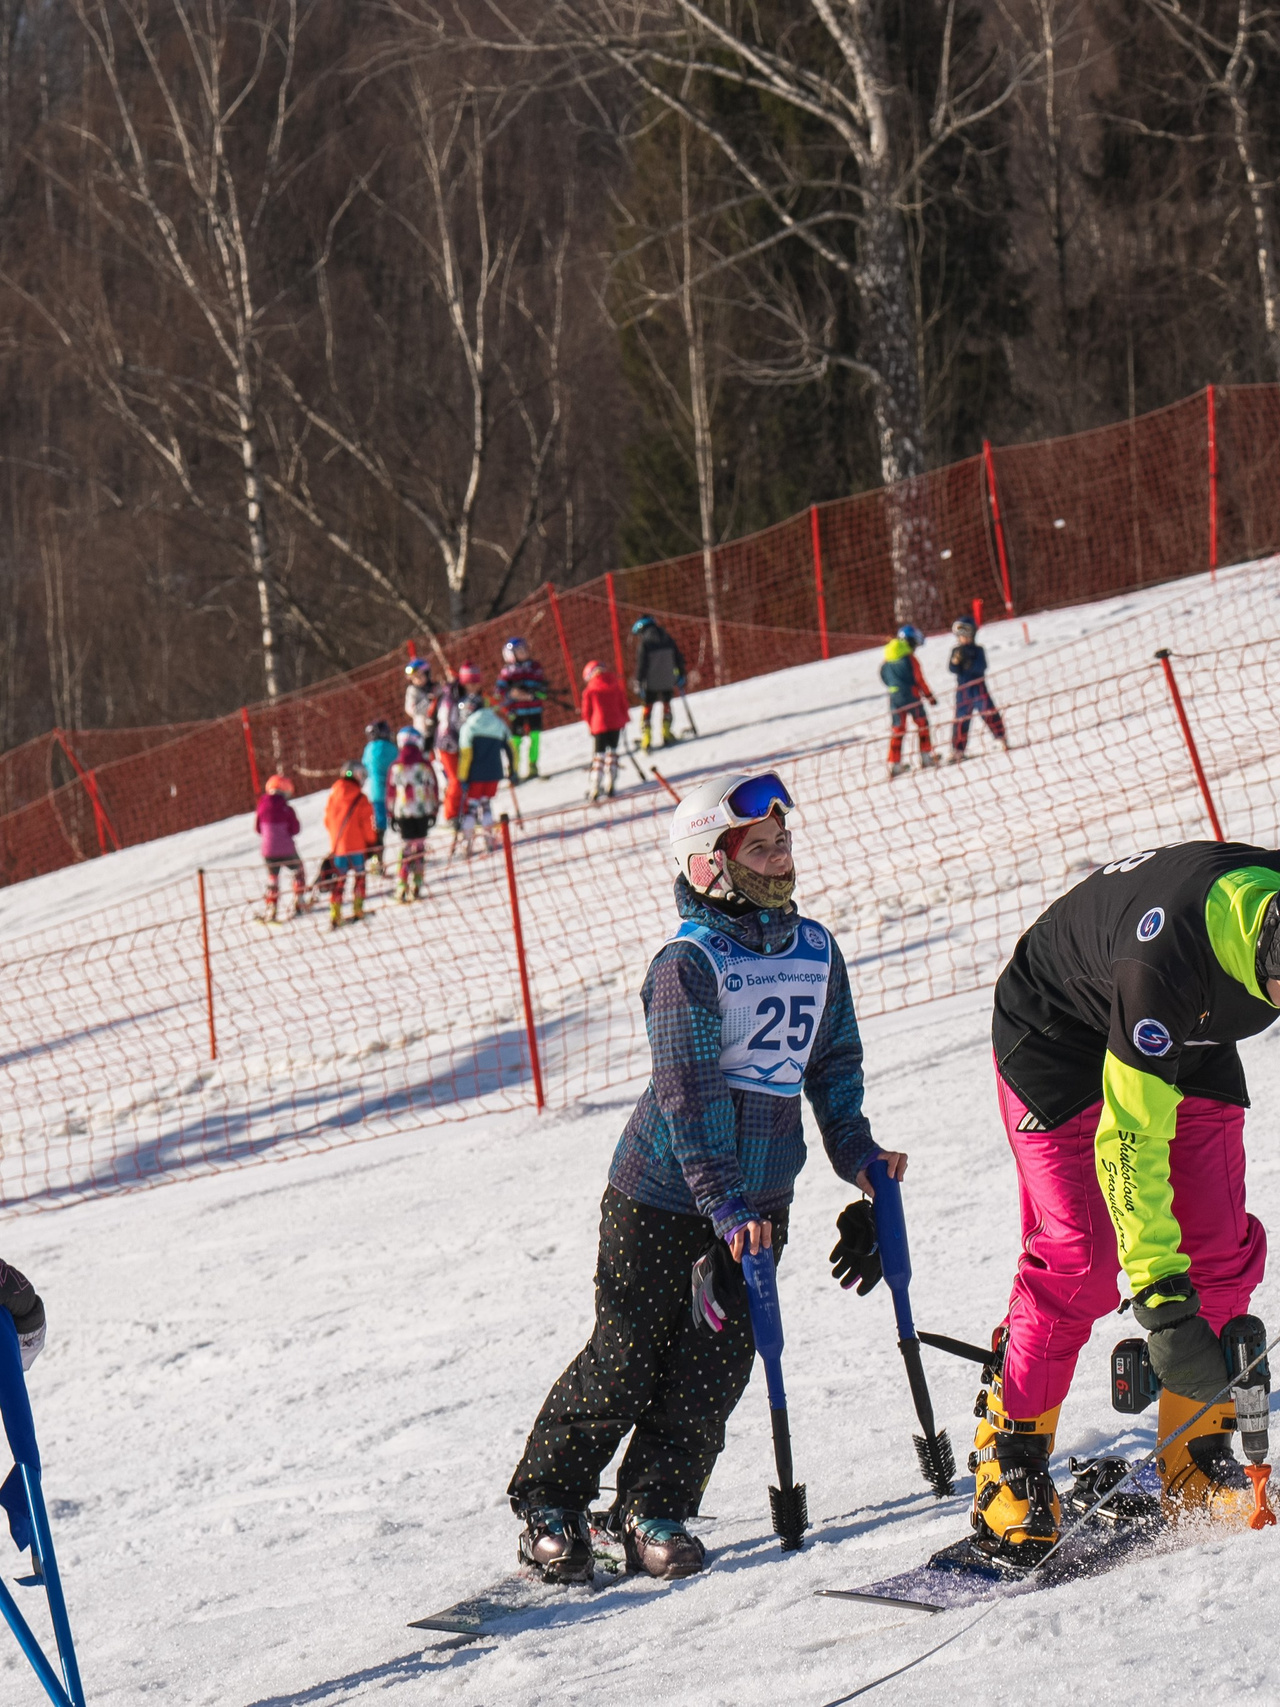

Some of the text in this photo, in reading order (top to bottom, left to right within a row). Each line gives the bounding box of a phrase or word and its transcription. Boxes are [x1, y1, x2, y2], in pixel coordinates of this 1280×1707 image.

[690, 814, 717, 829] ROXY
[746, 973, 777, 986] Банк
[747, 996, 816, 1051] 25
[1118, 1130, 1137, 1212] Shukolovo
